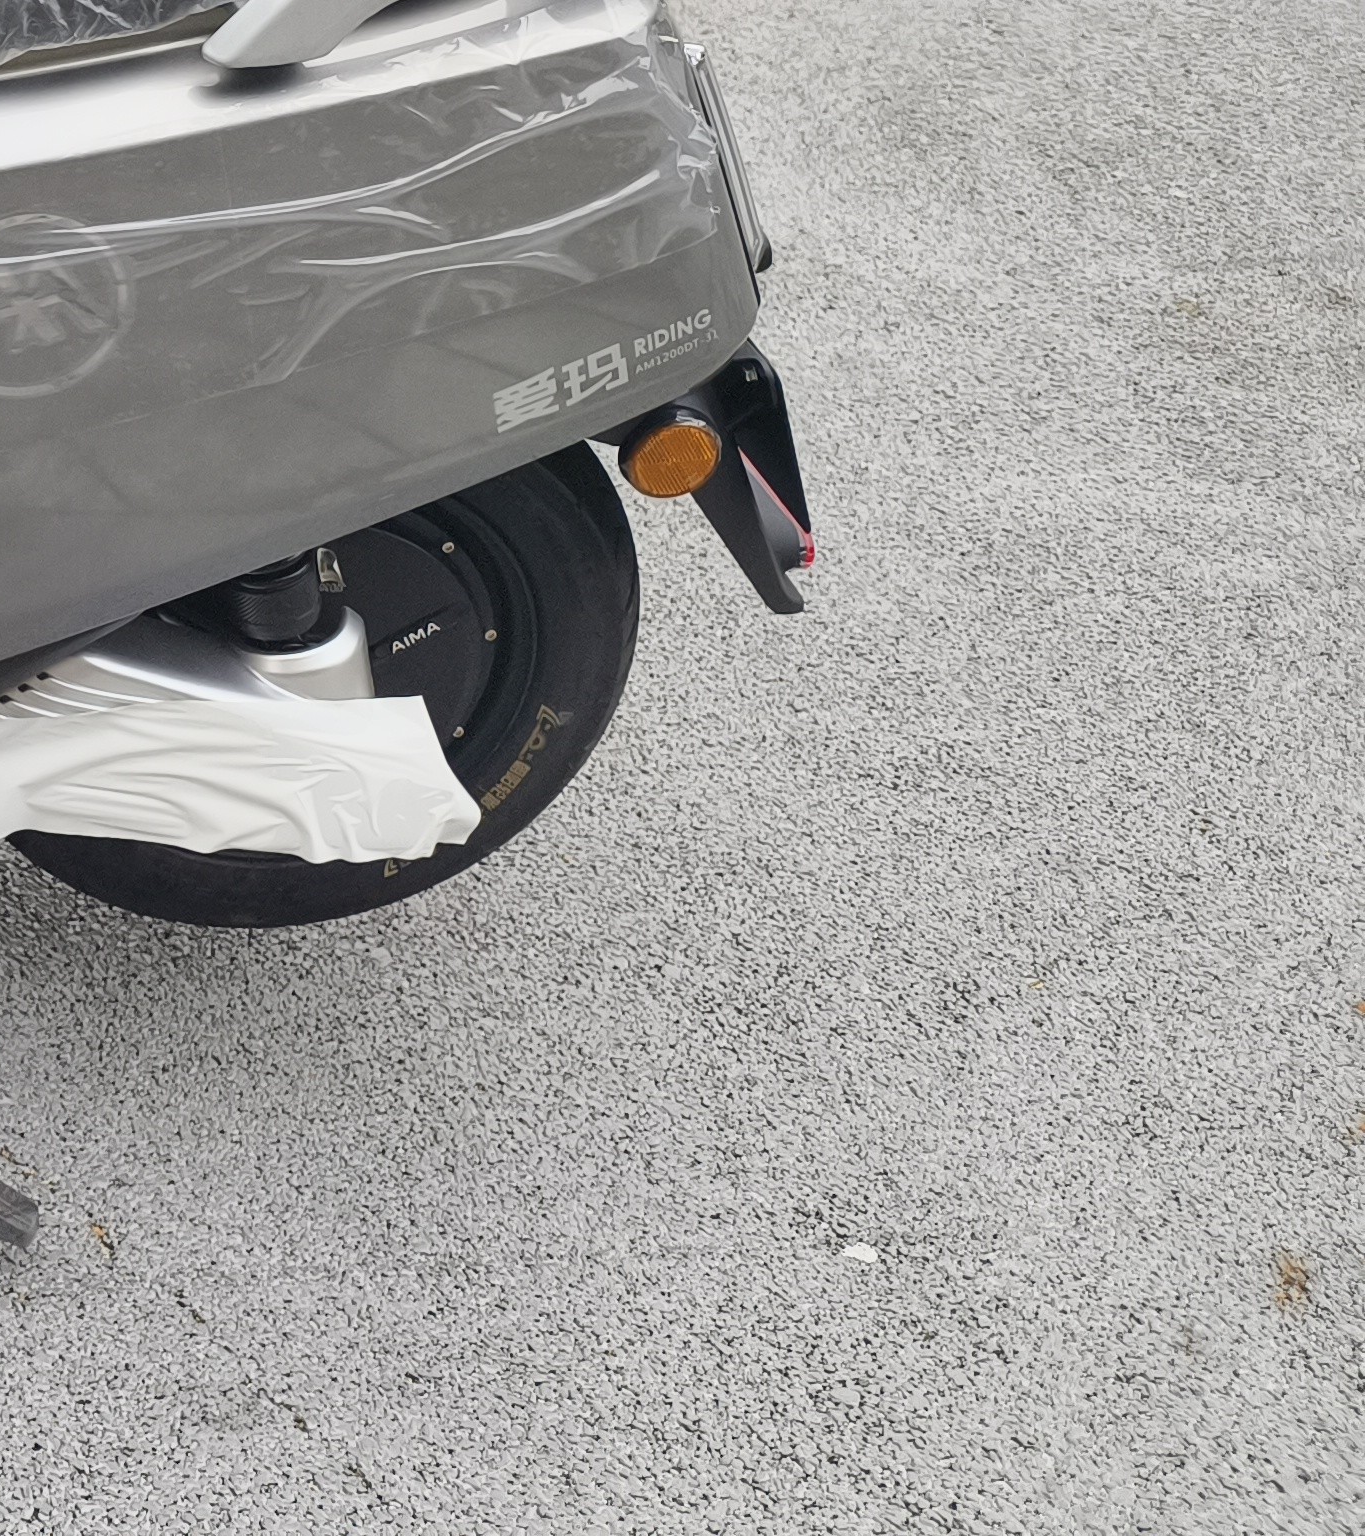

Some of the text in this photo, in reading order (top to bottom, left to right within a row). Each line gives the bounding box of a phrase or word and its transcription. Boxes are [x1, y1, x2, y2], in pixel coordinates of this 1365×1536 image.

[633, 308, 712, 358] RIDING
[492, 342, 629, 434] 爱玛
[392, 622, 441, 654] AIMA
